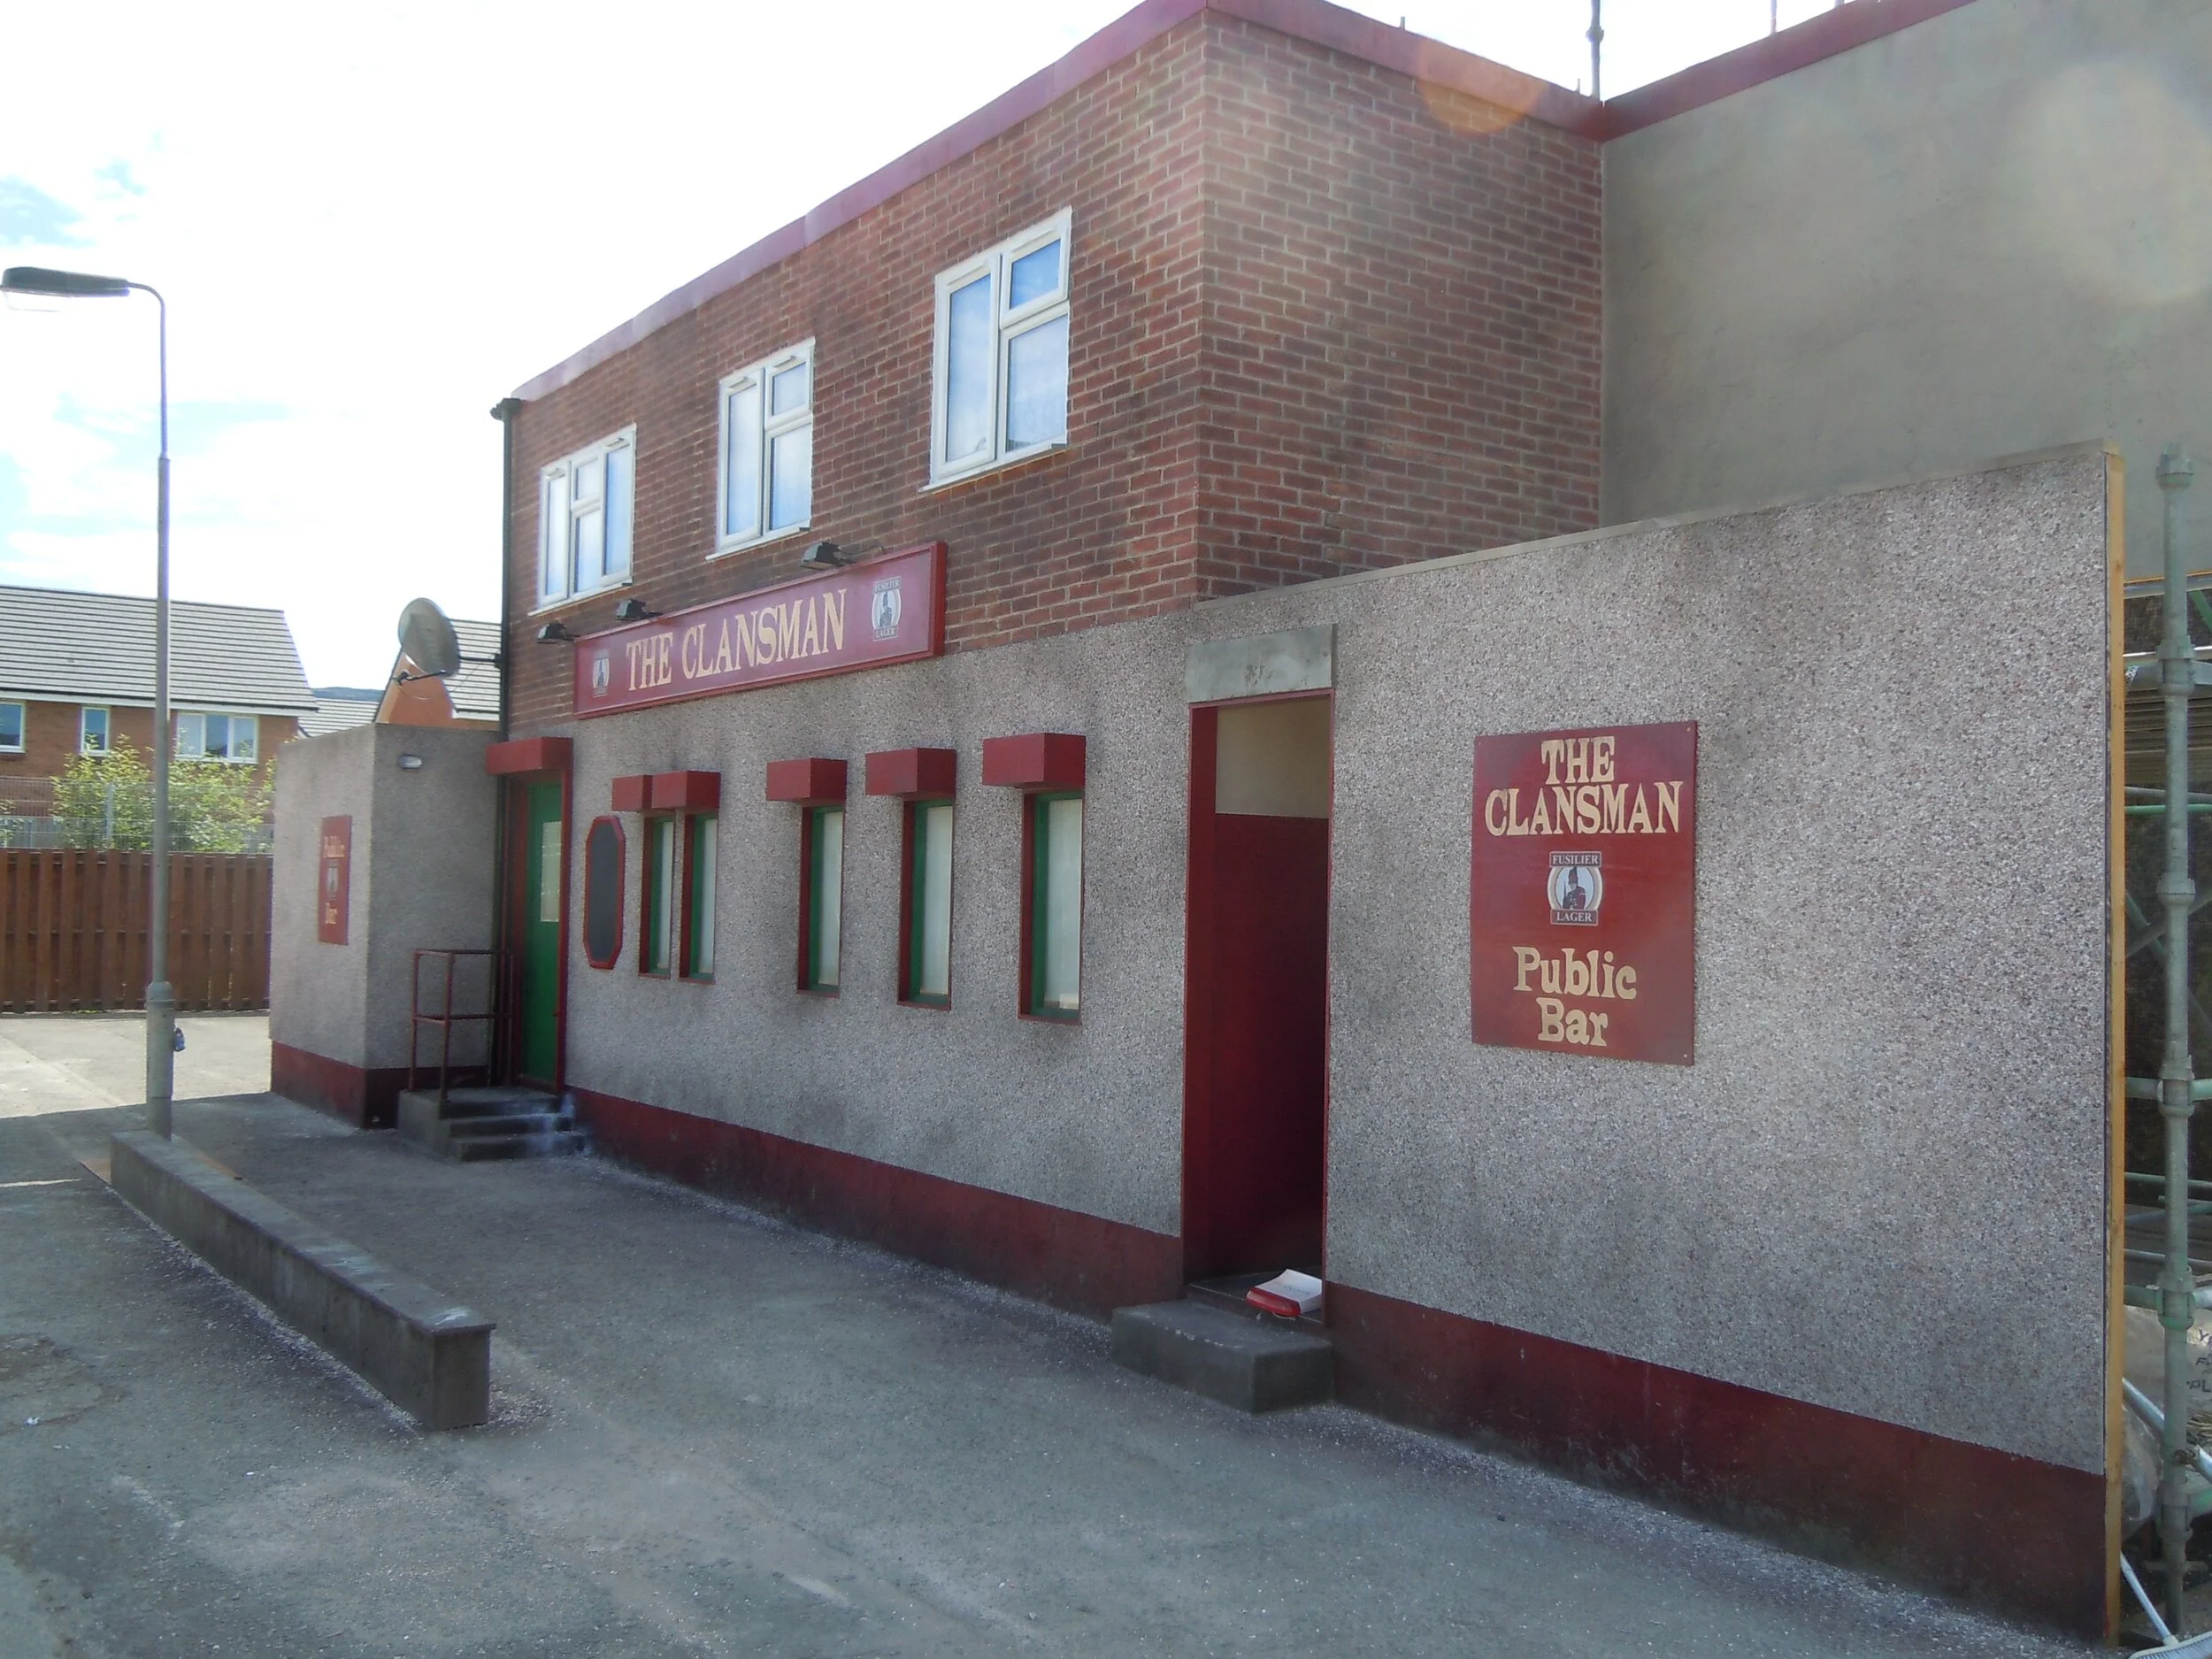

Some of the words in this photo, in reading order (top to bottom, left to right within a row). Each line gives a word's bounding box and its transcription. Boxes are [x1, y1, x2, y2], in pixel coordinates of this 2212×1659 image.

[626, 632, 673, 691] THE
[681, 588, 848, 680] CLANSMAN
[1540, 735, 1616, 786] THE
[1485, 780, 1683, 836] CLANSMAN
[1552, 854, 1599, 865] FUSILIER
[1556, 910, 1593, 922] LAGER
[1512, 946, 1637, 1001] Public
[1537, 997, 1609, 1047] Bar
